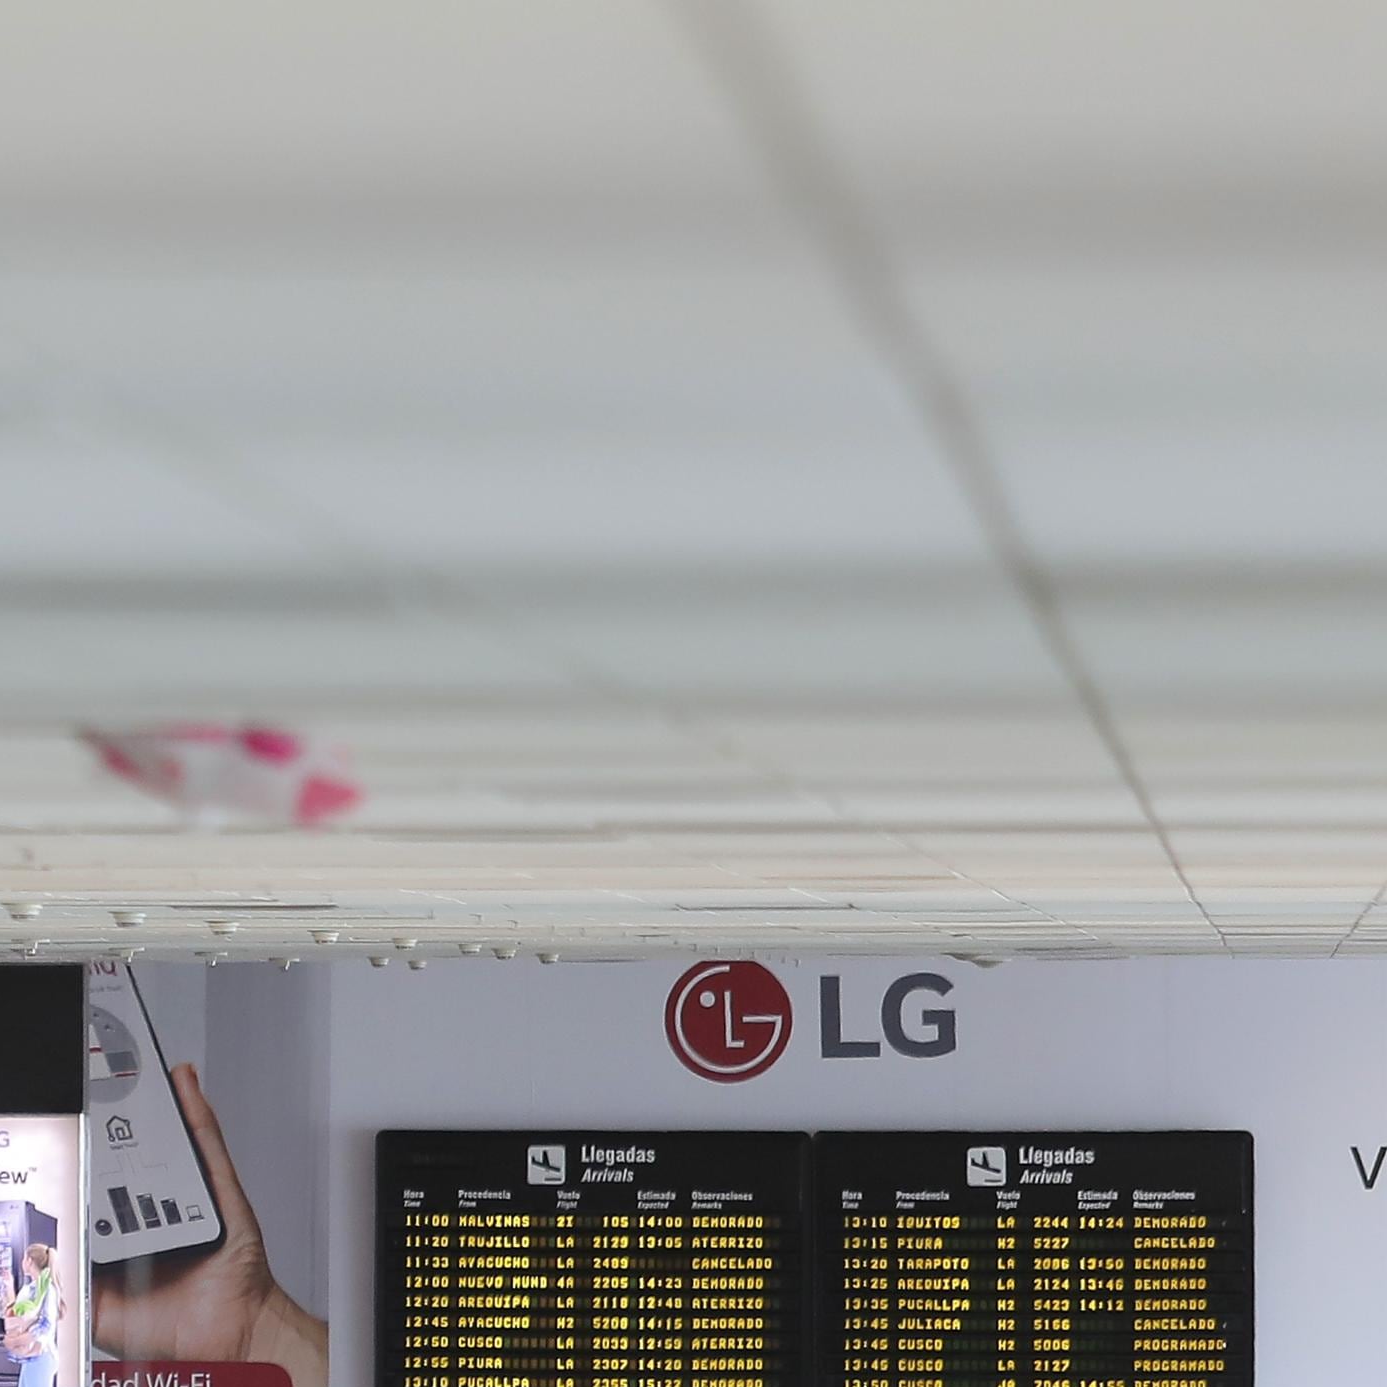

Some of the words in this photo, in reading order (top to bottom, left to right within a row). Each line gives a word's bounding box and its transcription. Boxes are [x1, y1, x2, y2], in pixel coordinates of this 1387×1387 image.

[819, 973, 958, 1058] LG
[581, 1145, 656, 1166] Llegadas
[1018, 1146, 1095, 1168] Llegadas
[581, 1168, 634, 1183] Arrivals
[1019, 1169, 1074, 1184] Arrivals
[406, 1214, 449, 1227] 11:00
[458, 1214, 530, 1228] MALVINAS
[556, 1215, 574, 1228] 2I
[603, 1216, 629, 1228] 105
[639, 1215, 683, 1228] 14:00
[692, 1216, 763, 1228] DEMORADO
[406, 1235, 449, 1248] 11:20
[458, 1235, 530, 1248] TRUJILLO
[556, 1236, 575, 1249] LA
[593, 1236, 629, 1249] 2129
[638, 1236, 682, 1249] 13:05
[692, 1236, 763, 1249] ATERRIZO
[845, 1298, 889, 1310] 13:35
[898, 1298, 970, 1311] PUCALLPA
[997, 1299, 1015, 1311] H2
[1033, 1299, 1070, 1312] 5423
[1080, 1299, 1124, 1311] 14:12
[1135, 1299, 1207, 1311] DEMORADO
[405, 1356, 449, 1369] 12:55
[458, 1357, 503, 1369] PIURA
[556, 1358, 574, 1370] LA
[592, 1358, 629, 1370] 2307
[638, 1358, 682, 1371] 14:20
[691, 1358, 763, 1371] DEMORADO
